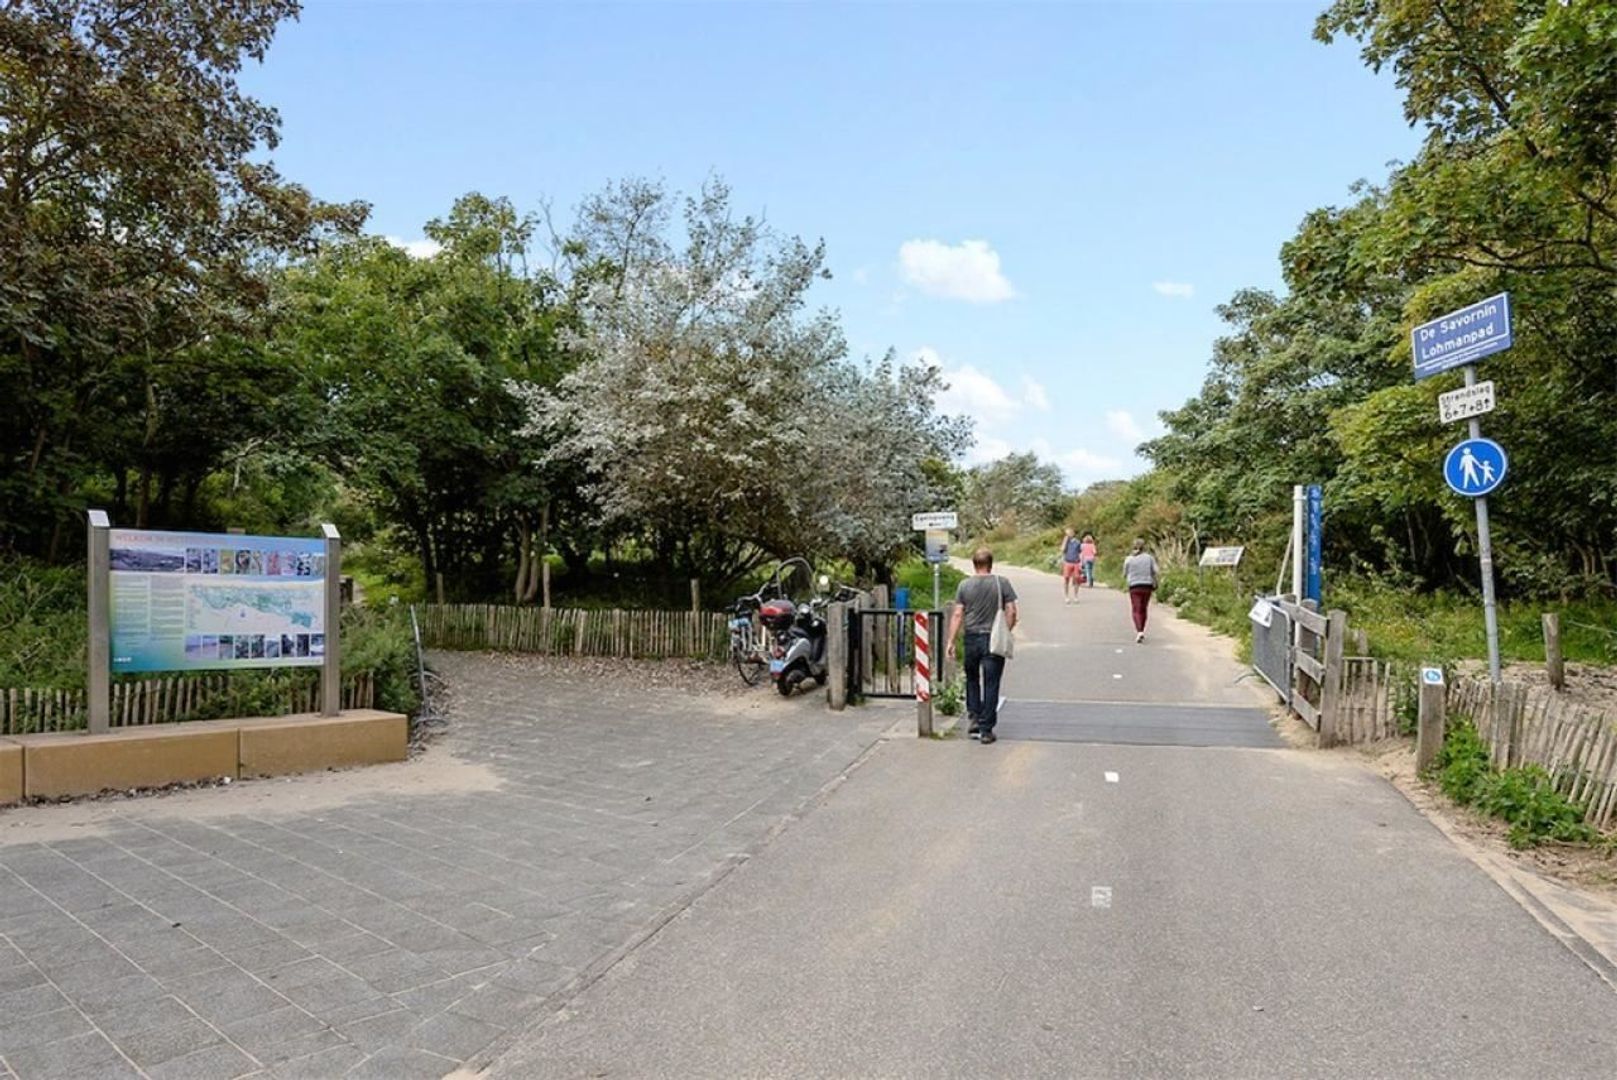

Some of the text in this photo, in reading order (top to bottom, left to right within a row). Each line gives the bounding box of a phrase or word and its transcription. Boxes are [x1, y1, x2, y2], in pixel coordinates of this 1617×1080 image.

[1420, 304, 1497, 342] De Savornin
[1421, 322, 1494, 360] Lohmanpad
